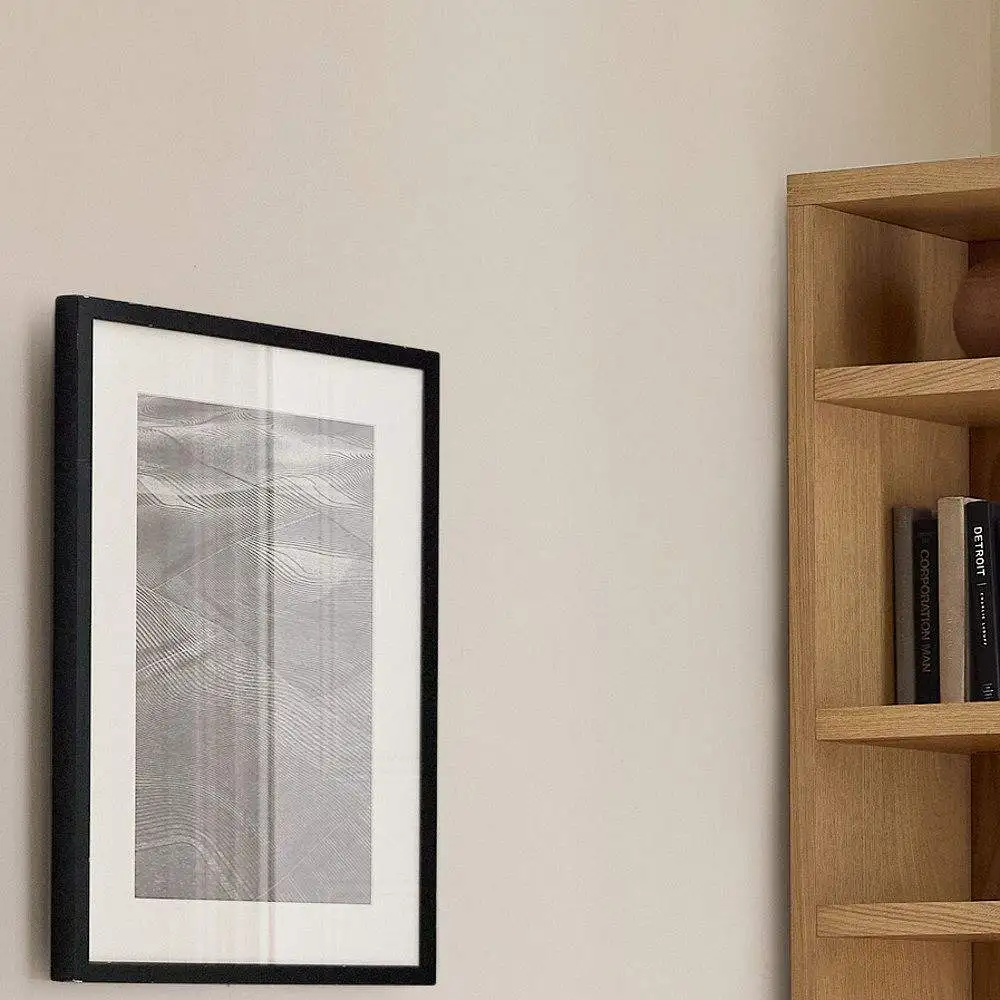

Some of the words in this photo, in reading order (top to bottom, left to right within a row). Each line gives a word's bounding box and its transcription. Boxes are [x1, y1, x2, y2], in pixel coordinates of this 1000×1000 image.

[973, 526, 986, 577] DETROIT
[919, 549, 930, 642] CORPORATION
[920, 644, 931, 673] MAN
